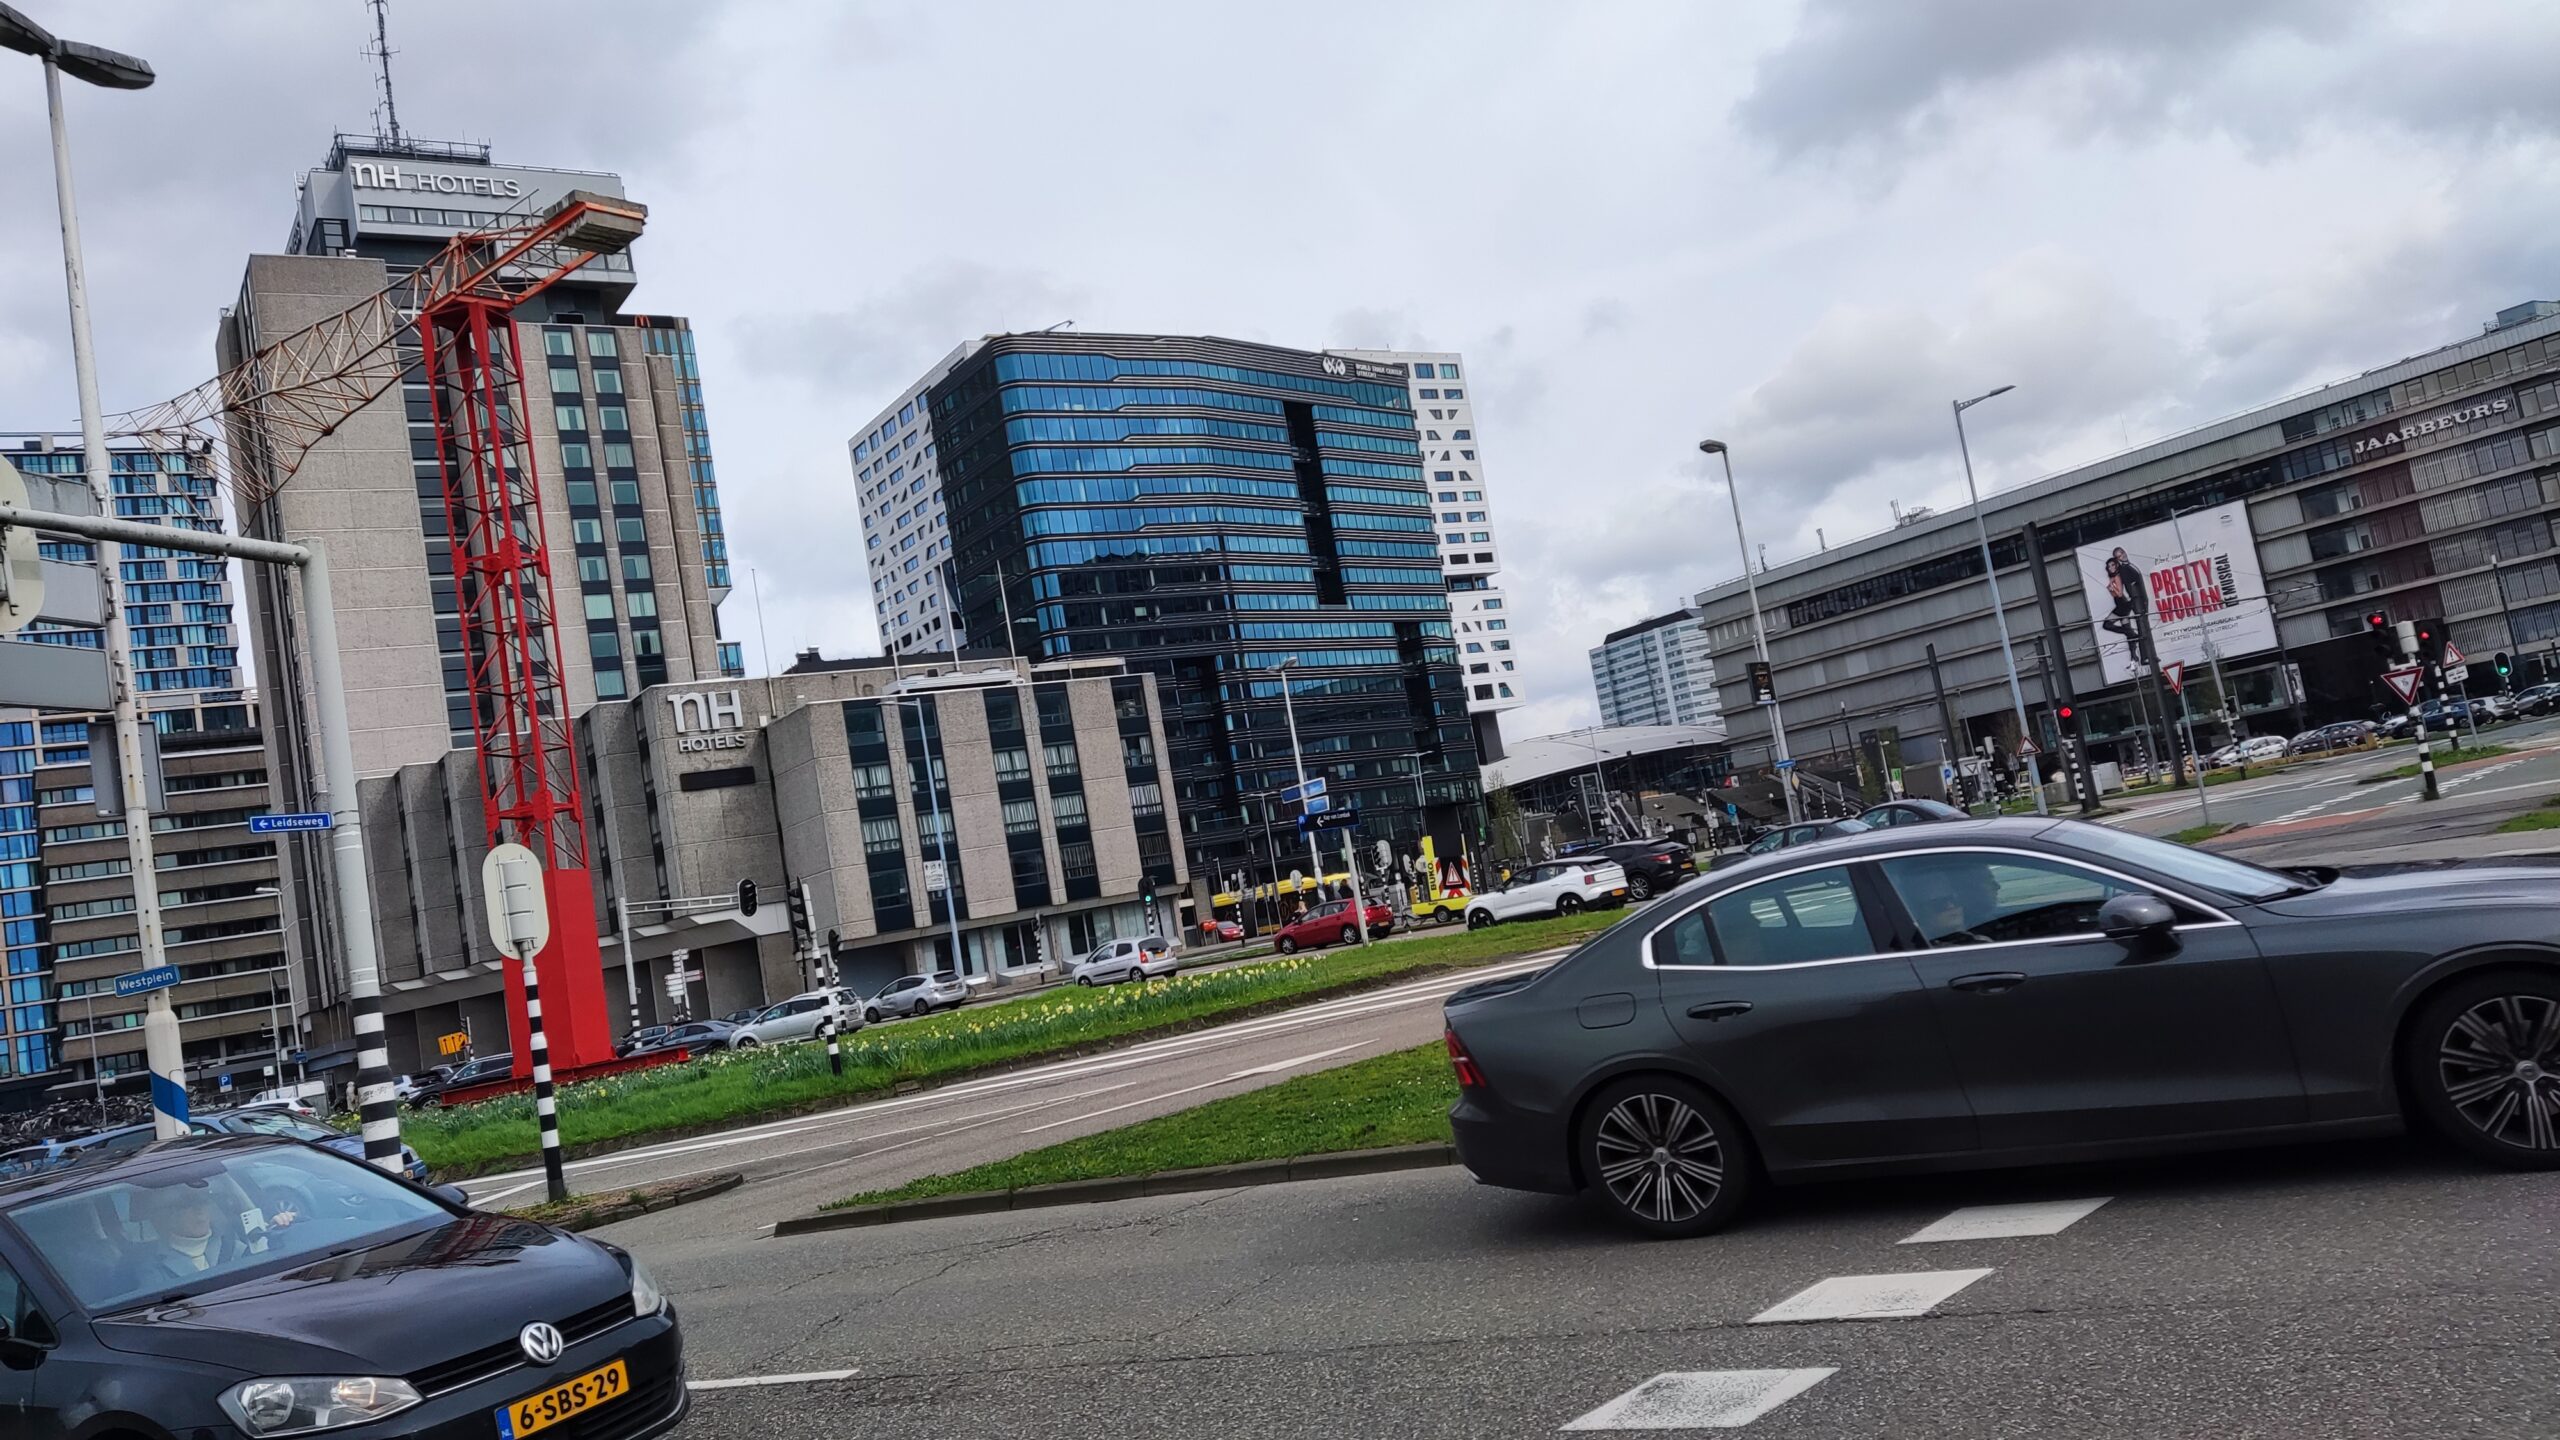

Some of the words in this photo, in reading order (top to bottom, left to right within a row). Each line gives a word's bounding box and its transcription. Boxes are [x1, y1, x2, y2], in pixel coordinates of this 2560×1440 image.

[416, 173, 521, 197] HOTELS
[2355, 399, 2508, 454] JAARBEURS
[2150, 557, 2213, 599] PRETTY
[2214, 552, 2237, 596] MUSICAL
[2155, 585, 2224, 623] WOMAN
[678, 733, 746, 753] HOTELS
[271, 818, 324, 828] Leidseweg
[118, 971, 174, 990] Westplein
[520, 1368, 619, 1430] 6-SBS-29
[501, 1428, 513, 1438] NL
